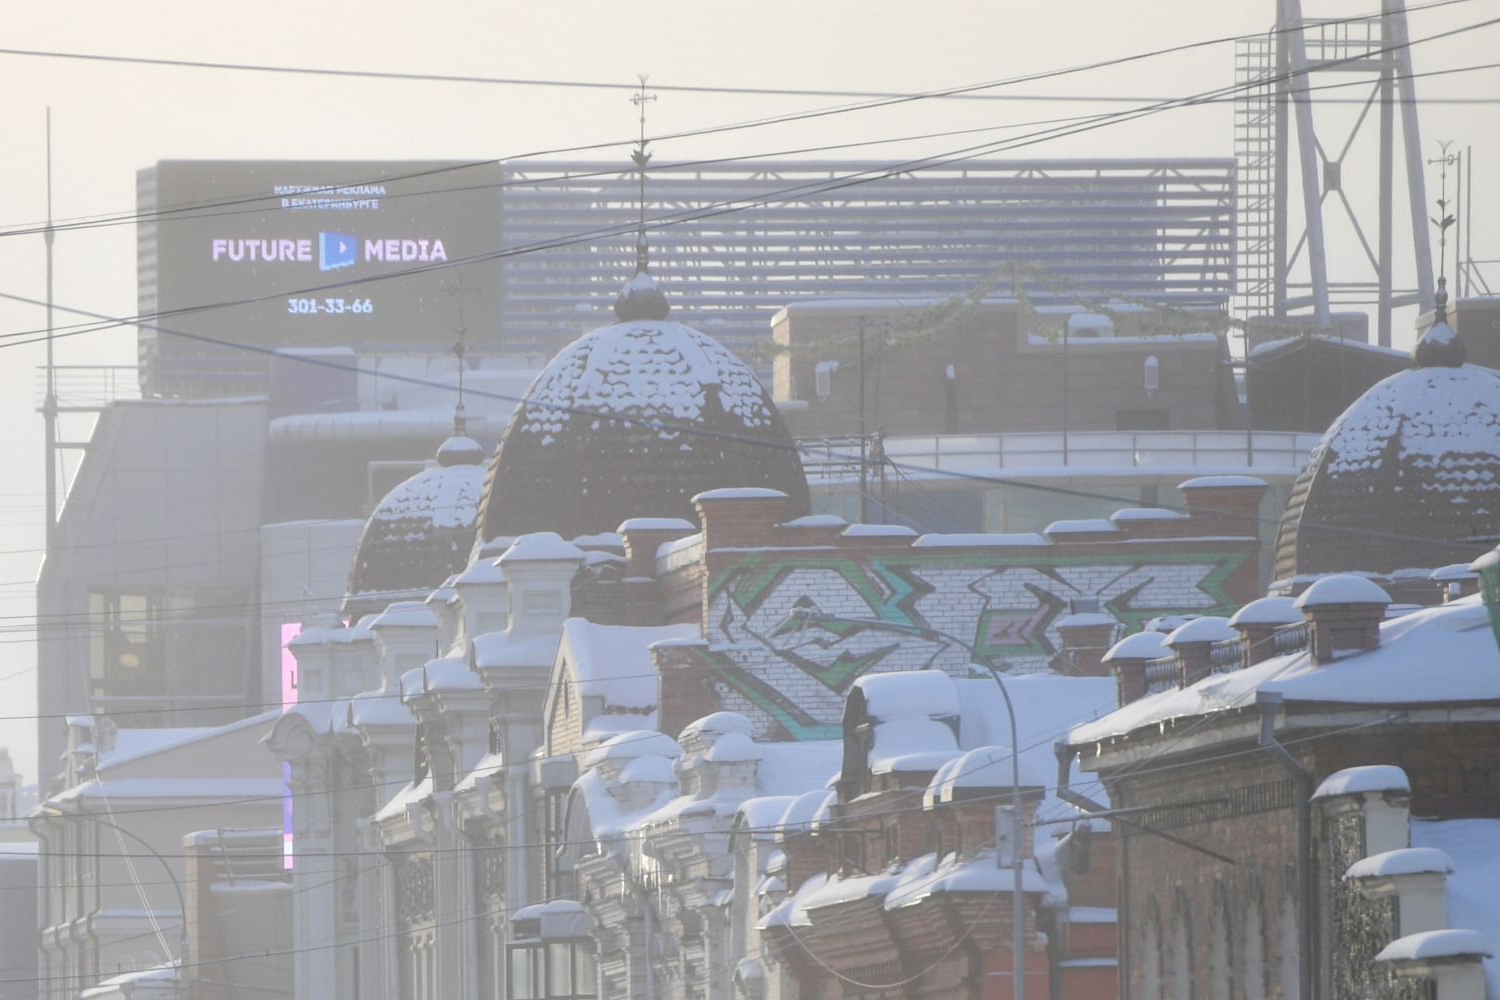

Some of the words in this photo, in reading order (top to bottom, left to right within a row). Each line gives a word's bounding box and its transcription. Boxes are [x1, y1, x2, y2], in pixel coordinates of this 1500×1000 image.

[292, 199, 379, 209] ЕКАТЕРИНБУРГЕ
[212, 239, 312, 262] FUTURE
[365, 239, 447, 262] MEDIA
[288, 299, 373, 314] 301-33-66
